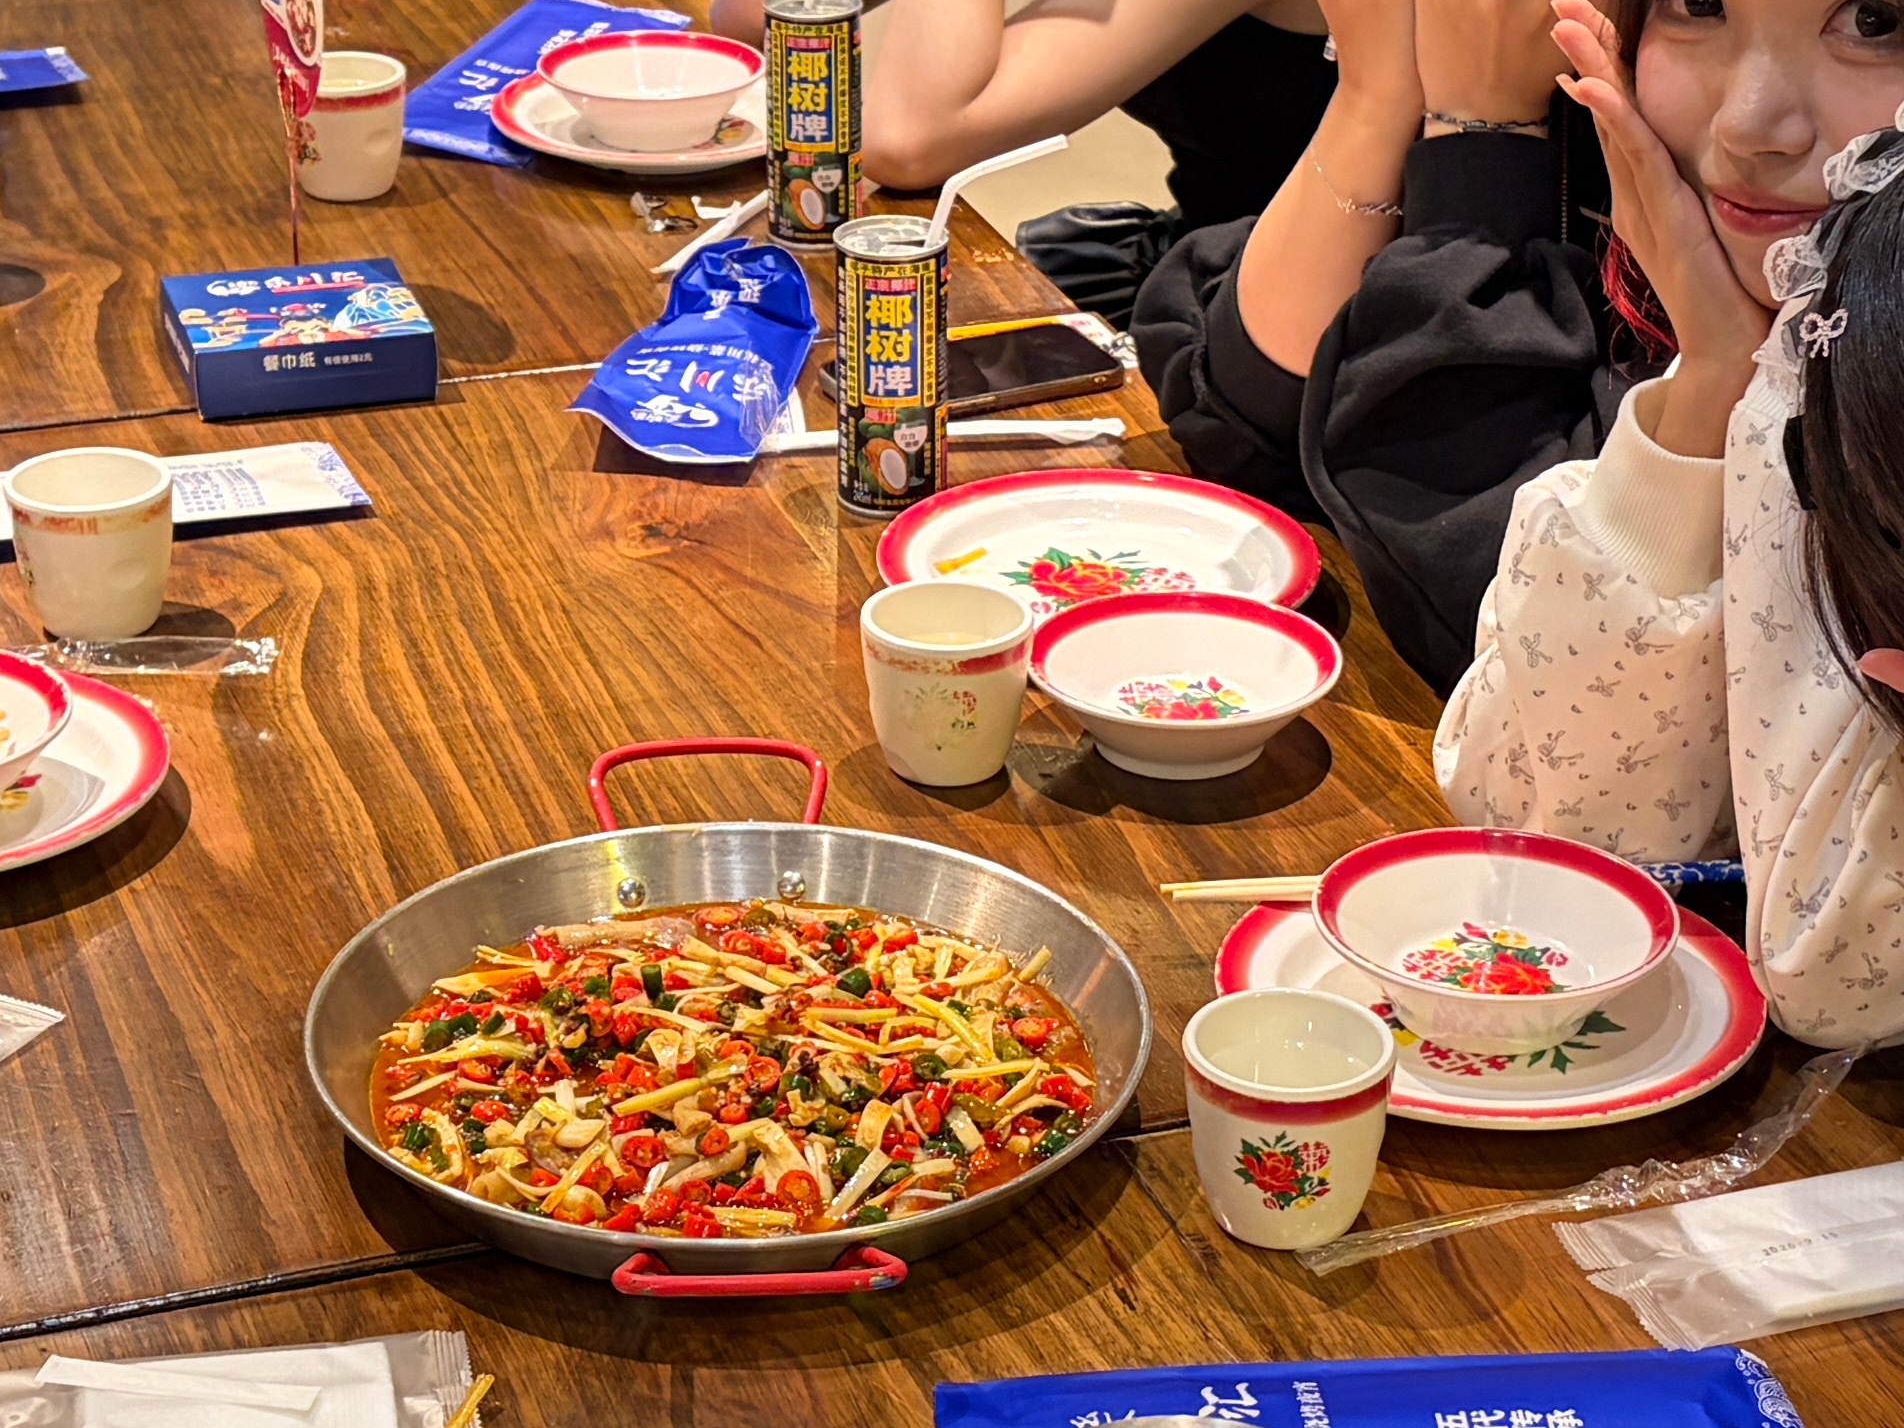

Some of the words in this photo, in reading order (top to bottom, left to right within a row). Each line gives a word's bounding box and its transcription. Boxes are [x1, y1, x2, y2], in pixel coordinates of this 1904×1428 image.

[787, 50, 829, 143] 椰树牌
[263, 351, 317, 372] 餐巾纸
[865, 294, 914, 397] 椰树牌
